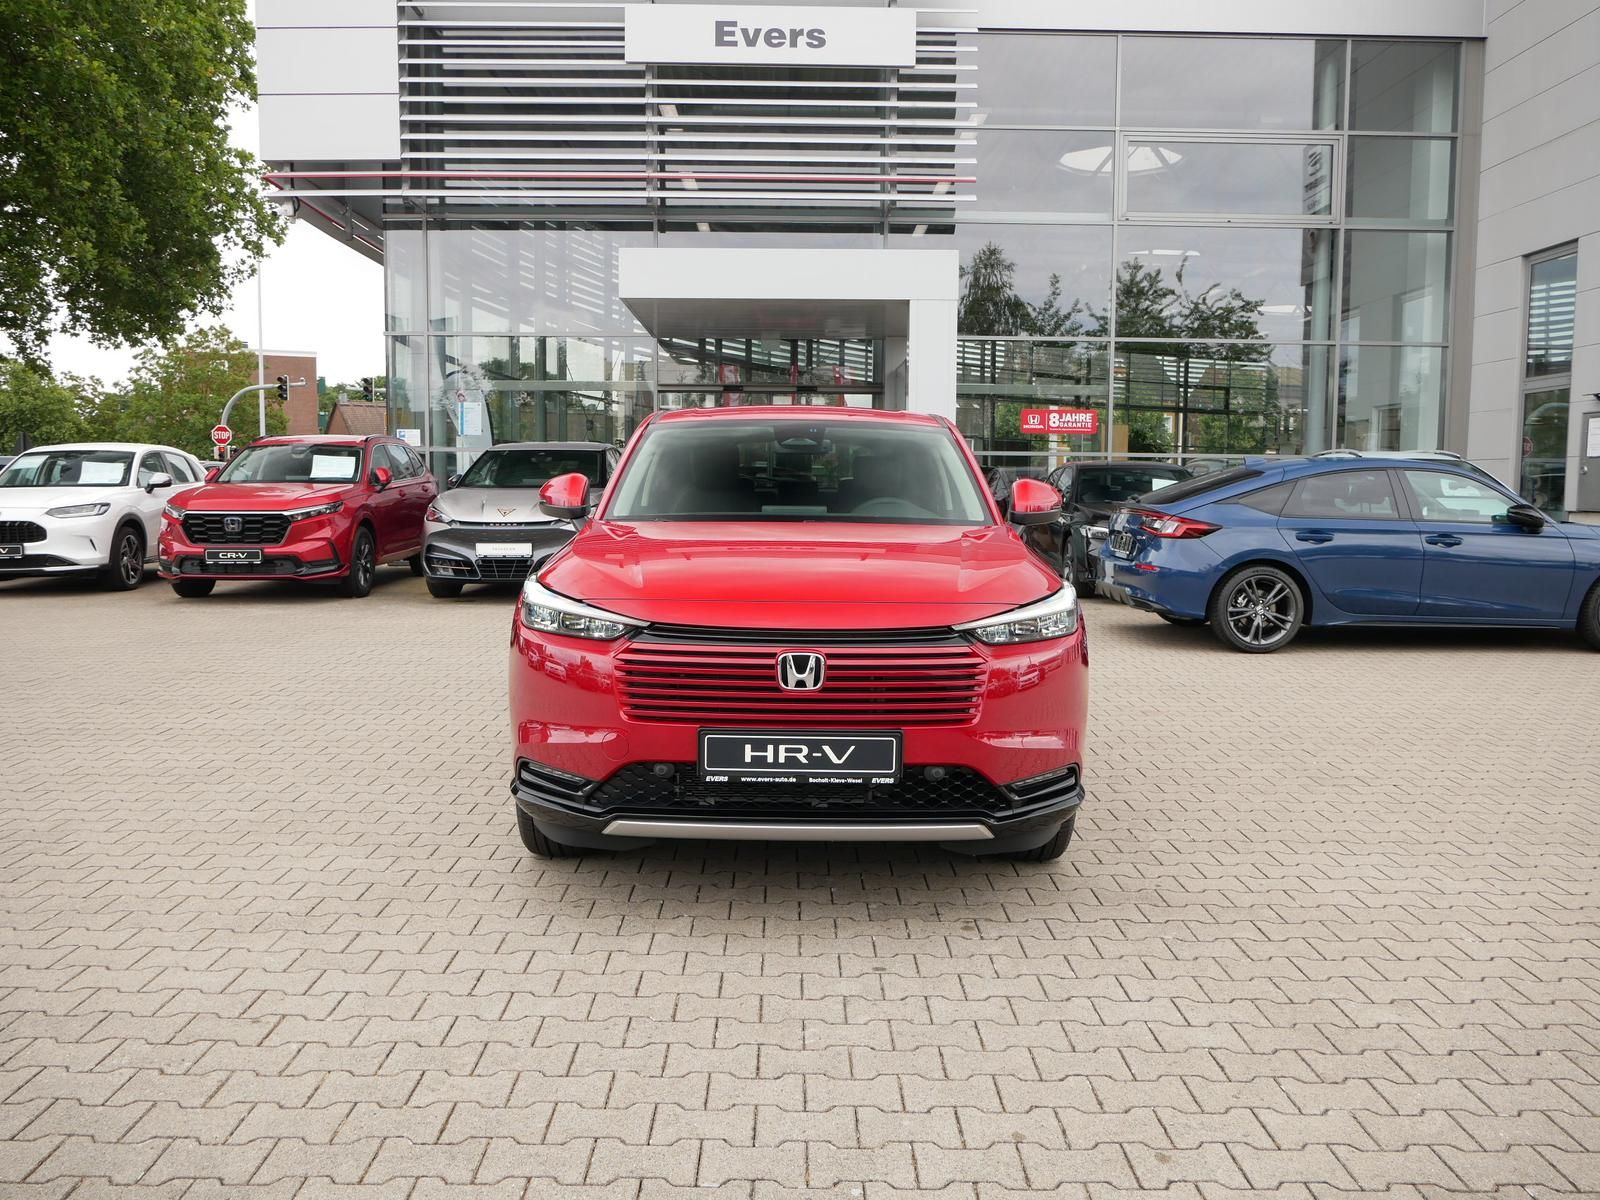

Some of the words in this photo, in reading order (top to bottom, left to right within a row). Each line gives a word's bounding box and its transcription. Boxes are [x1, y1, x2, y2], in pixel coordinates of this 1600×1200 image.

[715, 20, 827, 49] Evers
[1049, 412, 1060, 428] 8
[1060, 413, 1094, 422] JAHRE
[214, 431, 230, 440] STOP
[744, 743, 856, 764] HR-V
